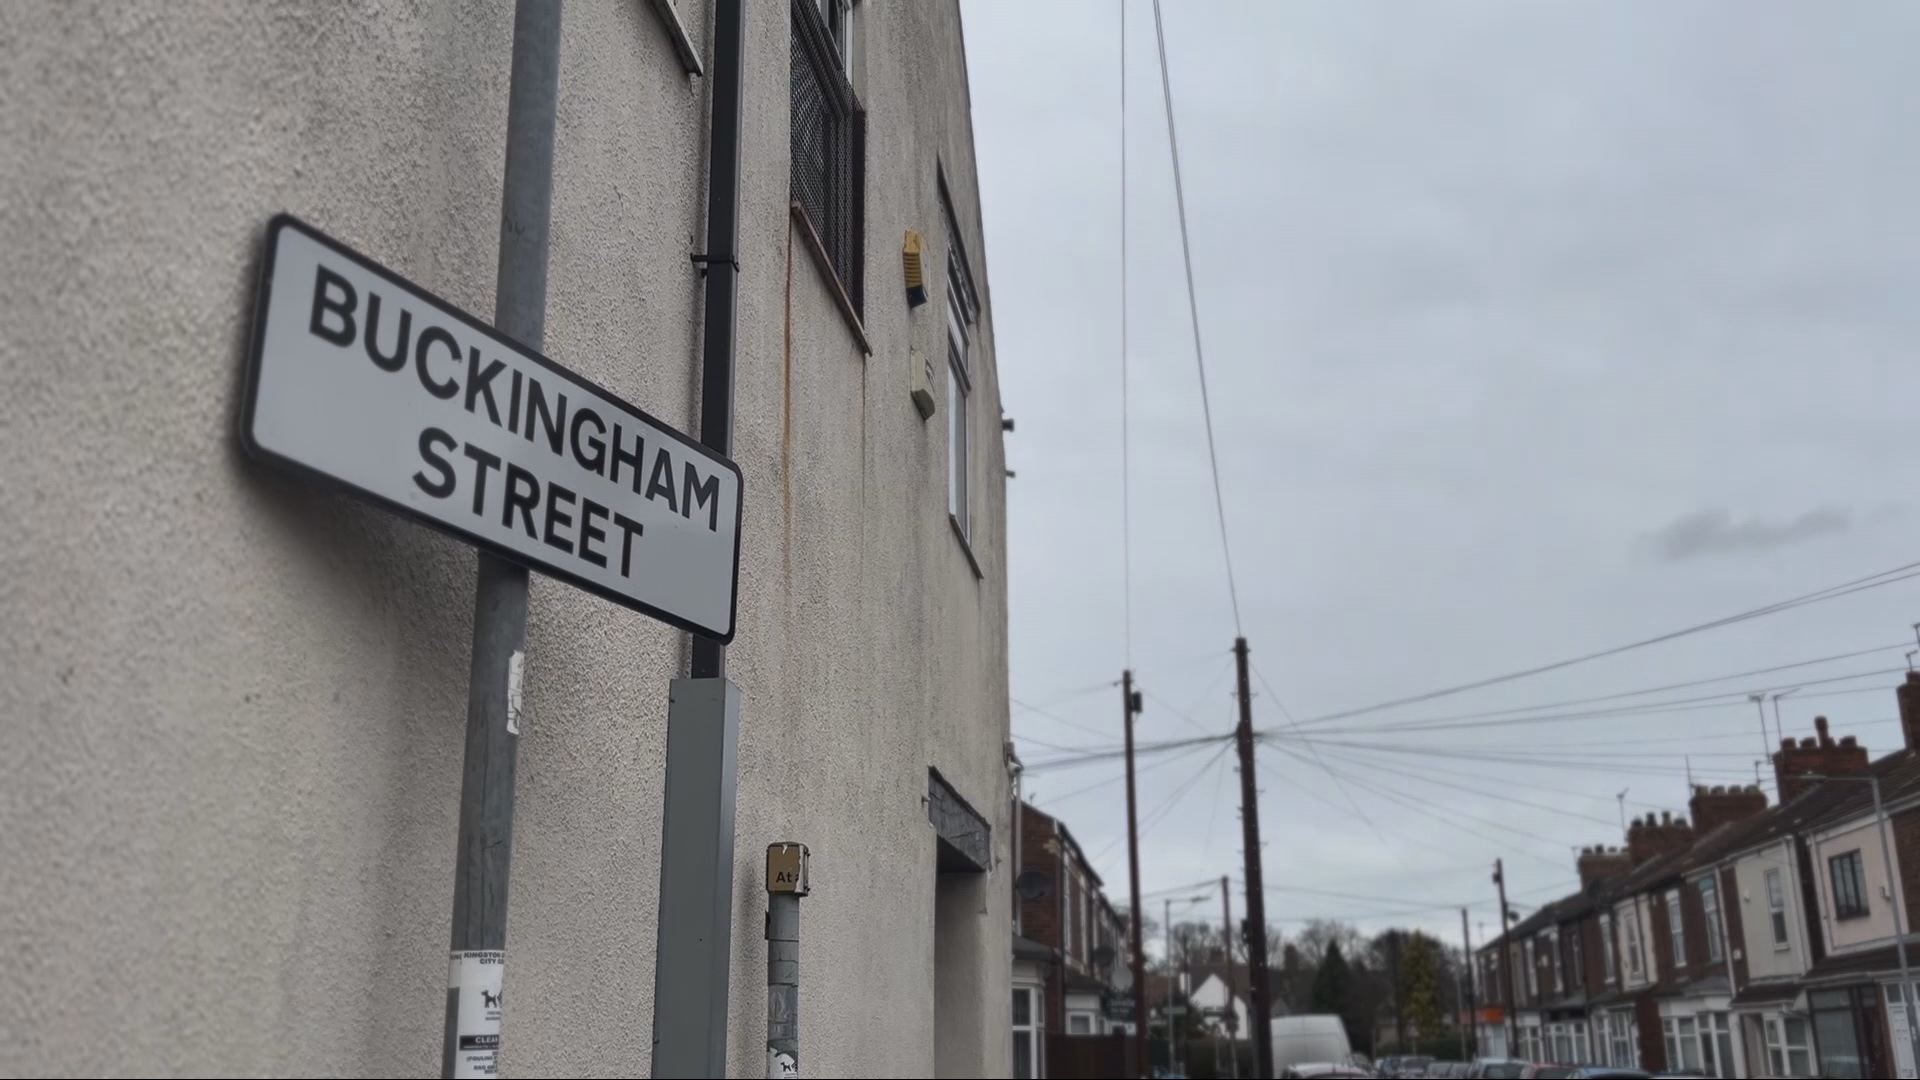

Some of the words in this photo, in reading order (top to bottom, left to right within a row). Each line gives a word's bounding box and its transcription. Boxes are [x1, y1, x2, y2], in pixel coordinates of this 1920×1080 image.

[308, 263, 720, 533] BUCKINGHAM
[413, 426, 644, 578] STREET
[776, 872, 792, 883] At
